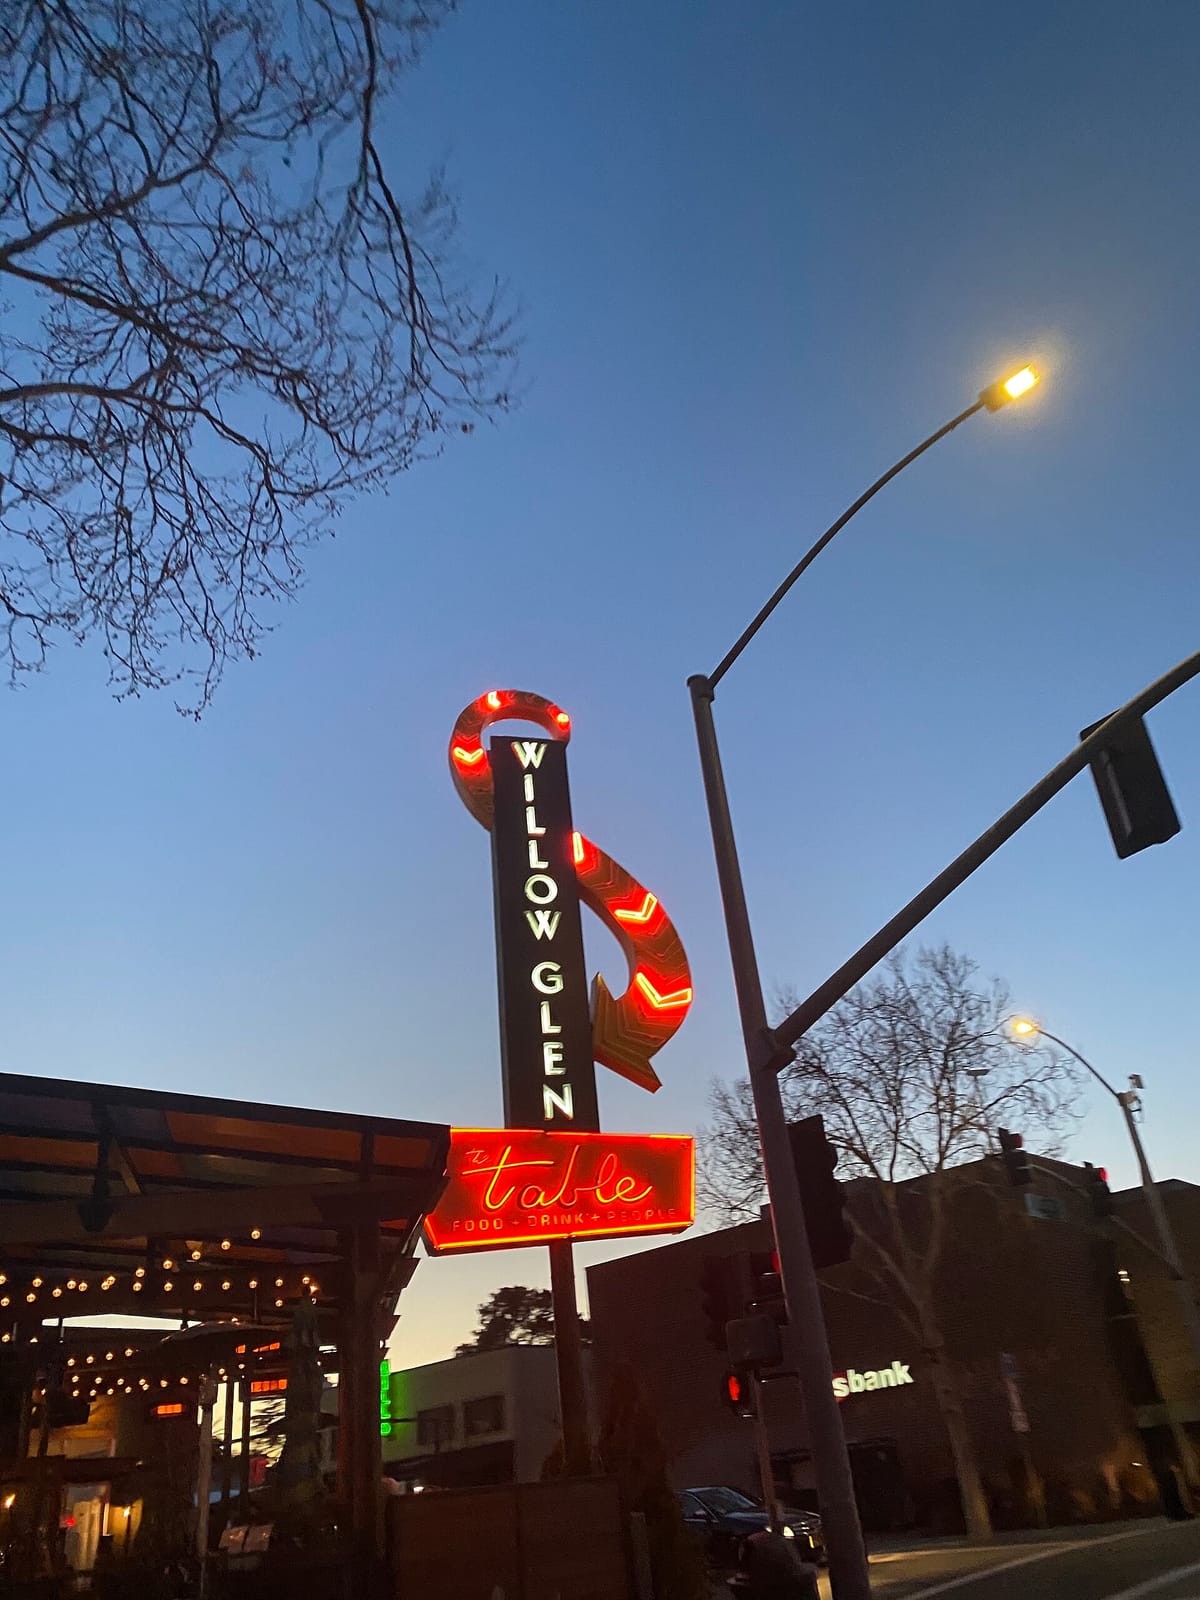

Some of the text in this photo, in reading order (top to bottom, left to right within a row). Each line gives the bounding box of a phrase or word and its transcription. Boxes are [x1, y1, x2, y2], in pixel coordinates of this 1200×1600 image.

[511, 741, 575, 1121] WILLOW GLEN
[461, 1145, 653, 1210] table
[452, 1217, 504, 1232] FOOD
[527, 1212, 585, 1228] DRINK
[607, 1207, 677, 1222] PEOPLE
